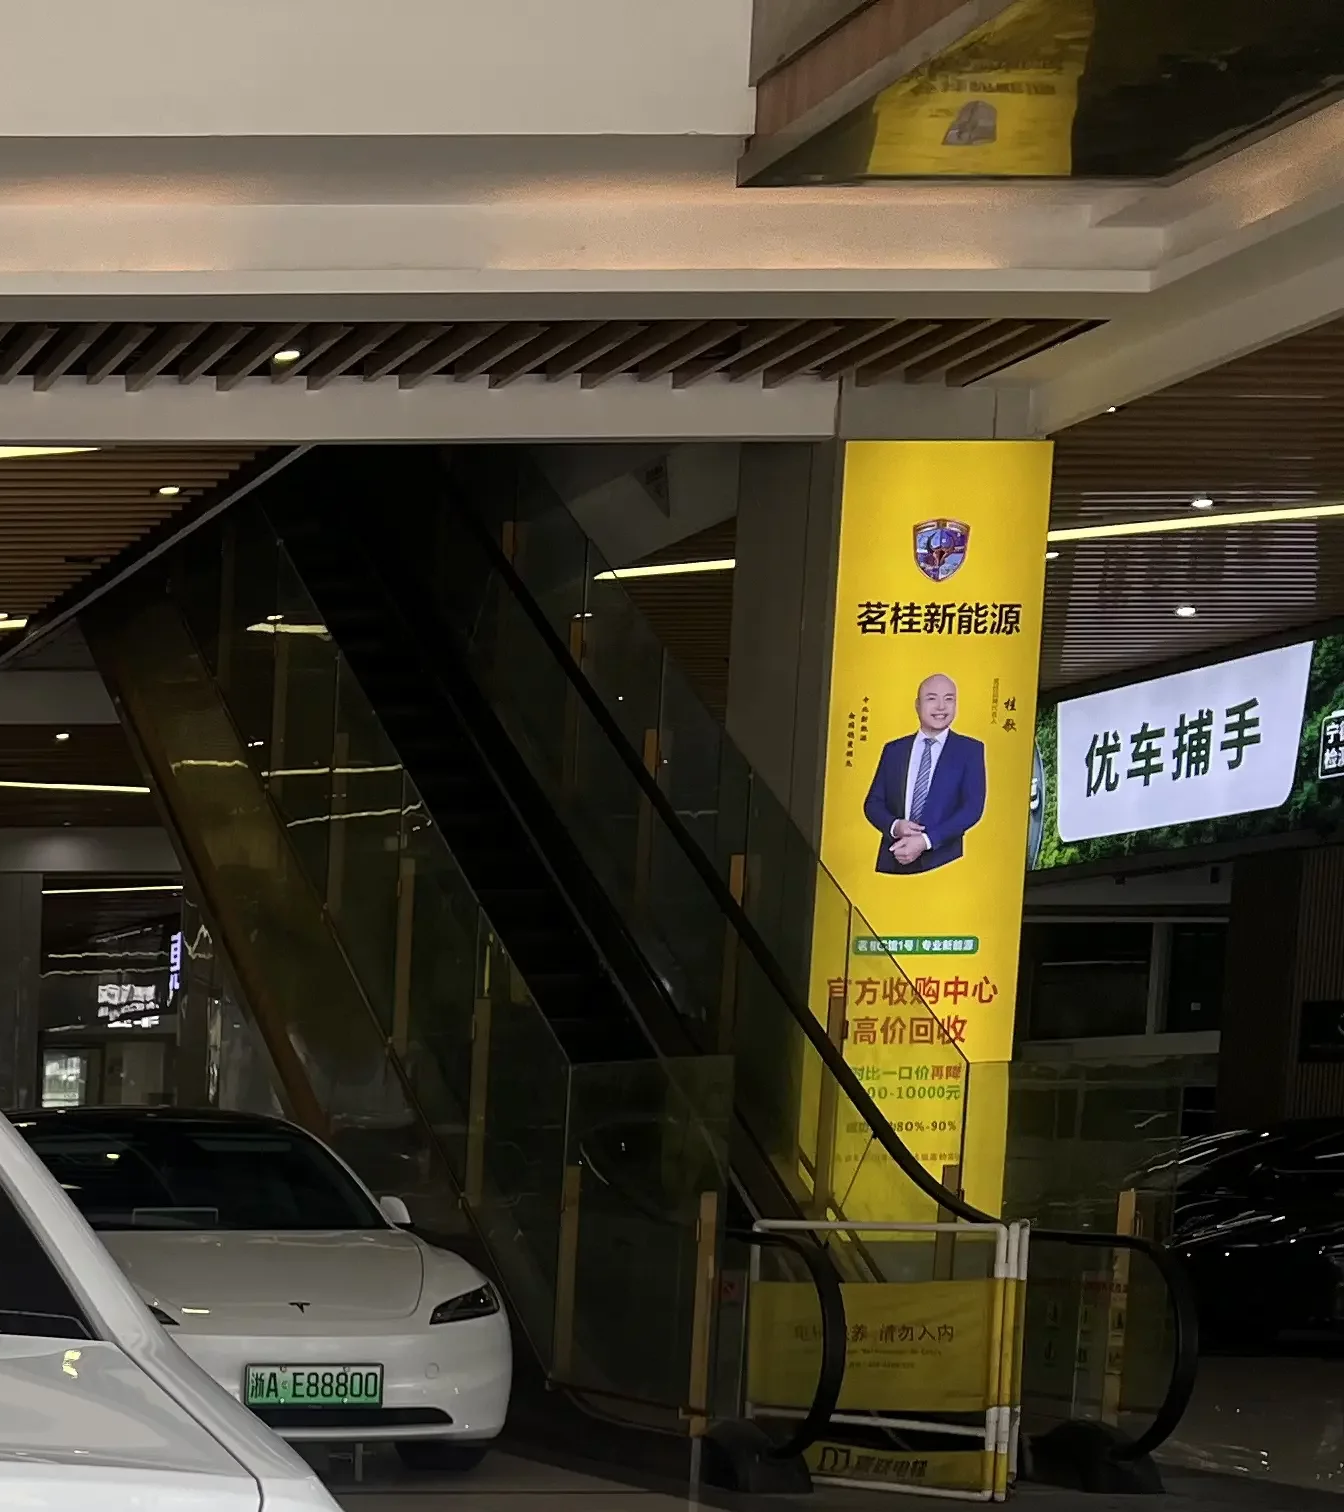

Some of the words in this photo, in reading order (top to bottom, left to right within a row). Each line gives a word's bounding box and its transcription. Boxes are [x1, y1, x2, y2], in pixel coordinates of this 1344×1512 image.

[856, 602, 1022, 636] 茗桂新能源
[1084, 697, 1262, 798] 优车捕手
[292, 1372, 379, 1399] E88800
